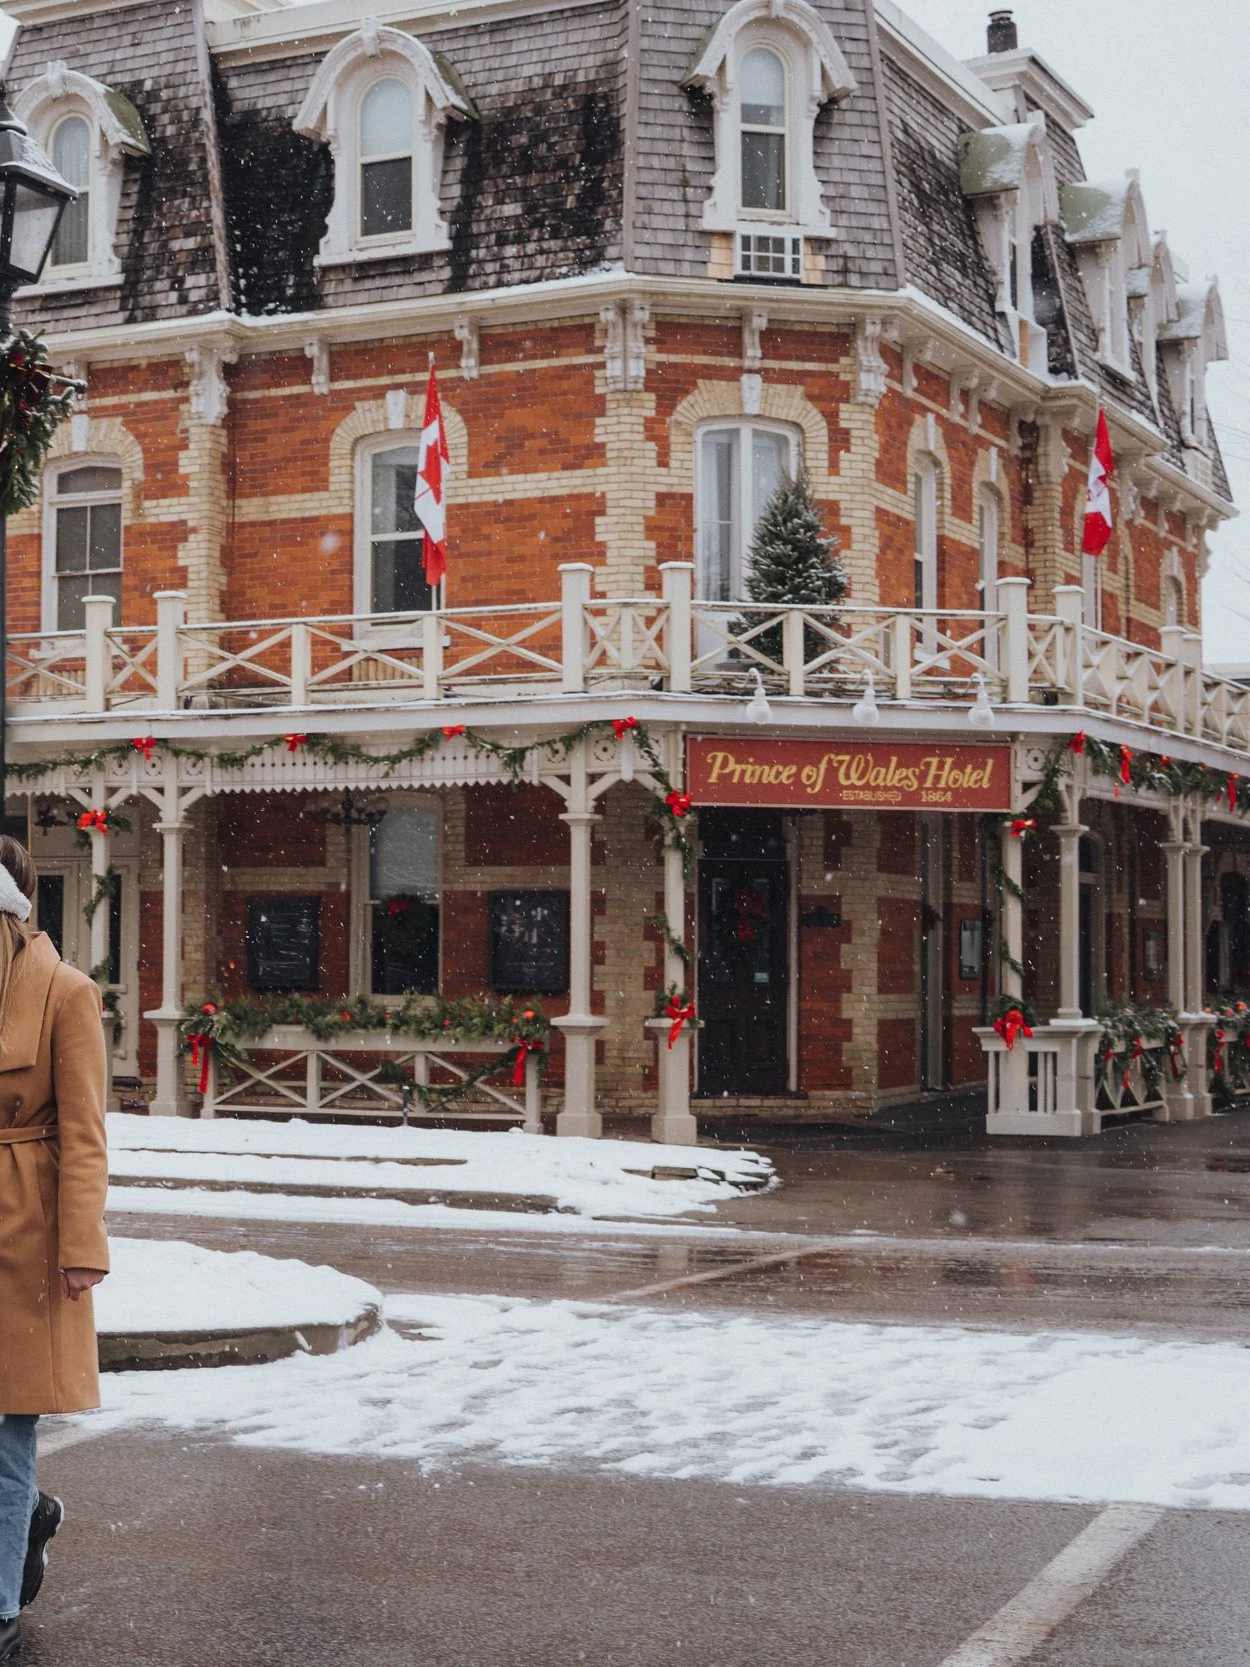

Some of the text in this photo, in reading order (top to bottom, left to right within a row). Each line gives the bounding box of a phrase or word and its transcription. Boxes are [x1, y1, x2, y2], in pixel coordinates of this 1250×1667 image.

[707, 752, 994, 793] Prince of Wales Hotel
[842, 790, 952, 802] ESTABLISHED 1864
